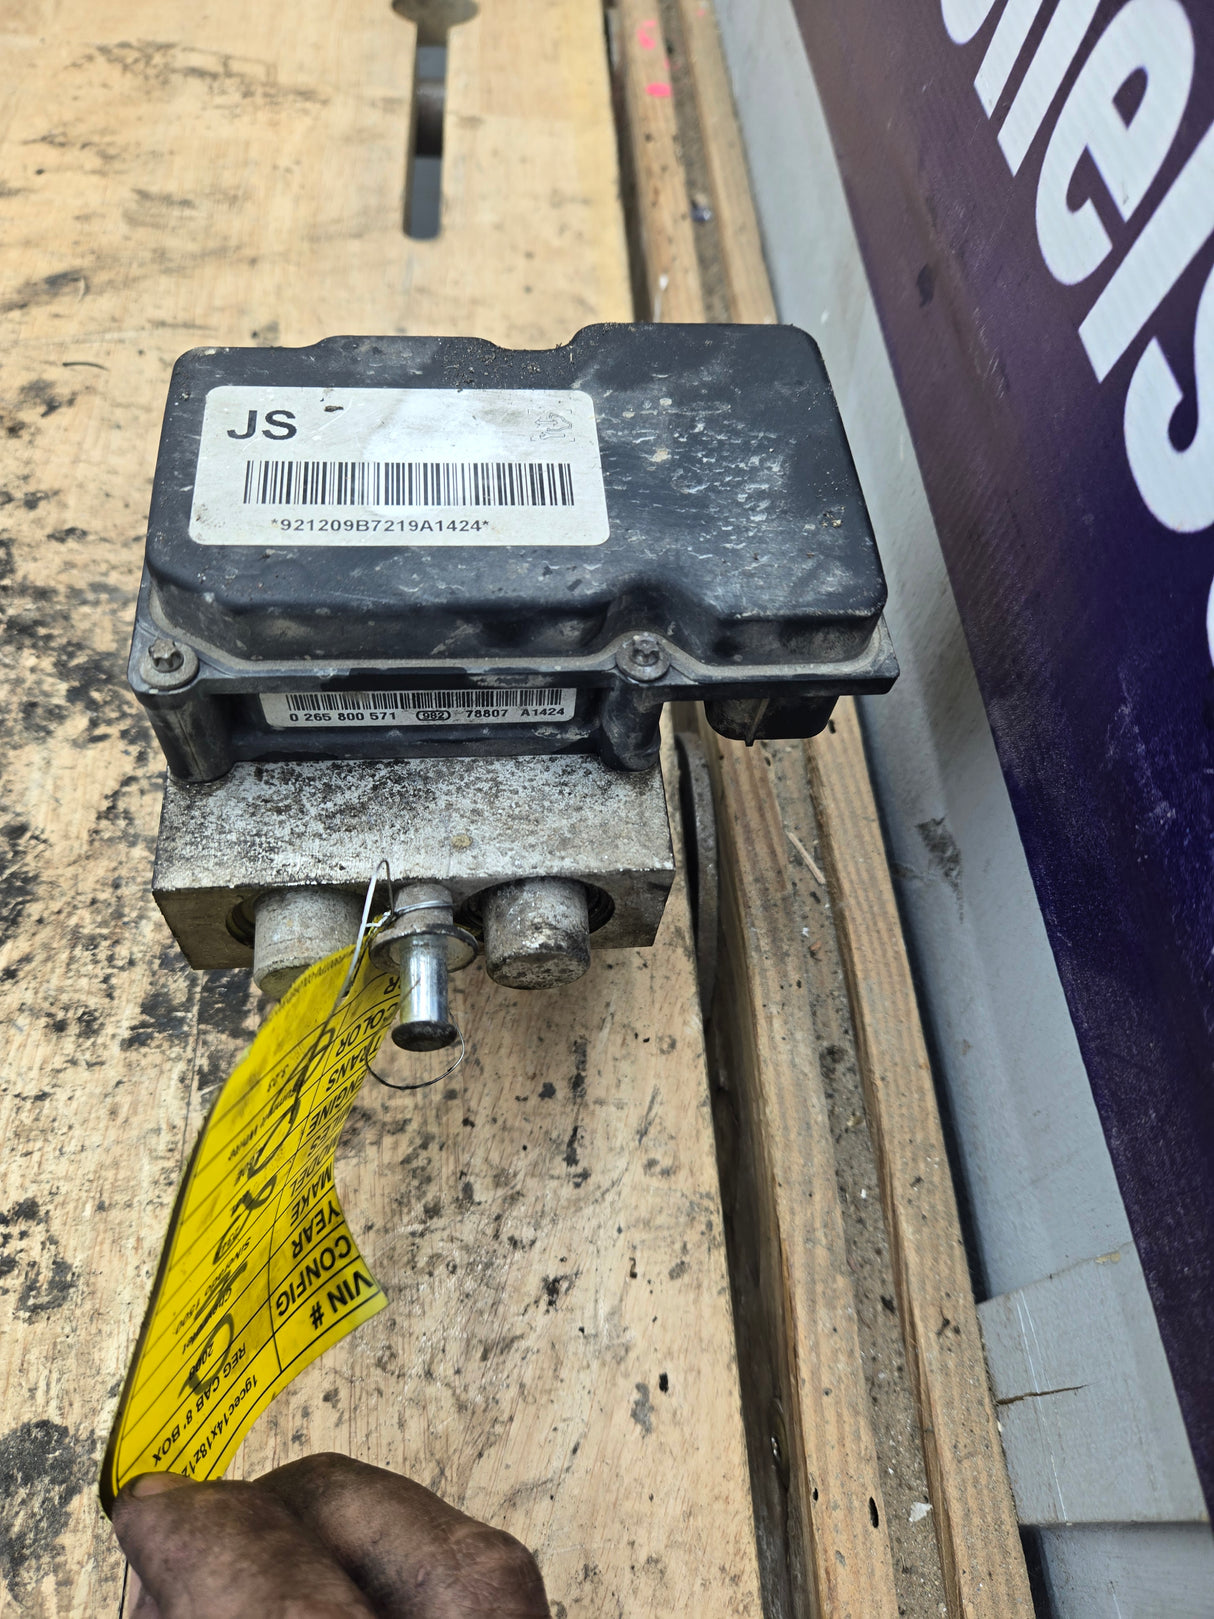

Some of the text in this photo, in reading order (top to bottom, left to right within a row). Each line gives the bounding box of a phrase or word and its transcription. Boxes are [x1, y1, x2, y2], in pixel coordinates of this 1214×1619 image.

[227, 408, 298, 441] JS
[304, 711, 332, 722] 265
[337, 711, 365, 722] 800
[369, 710, 397, 721] 571
[465, 708, 509, 719] 78807
[520, 706, 566, 718] A1424
[335, 1001, 399, 1058] COLOR
[326, 1035, 382, 1093] TRANS
[305, 1070, 368, 1138] ENGINE
[289, 1132, 339, 1198] MODEL
[289, 1166, 333, 1228] MAKE
[291, 1200, 341, 1259] YEAR
[275, 1234, 352, 1318] CONFIG
[309, 1270, 374, 1331] VIN #
[222, 1341, 247, 1379] REG
[195, 1376, 220, 1413] CAB
[152, 1424, 181, 1468] BOX
